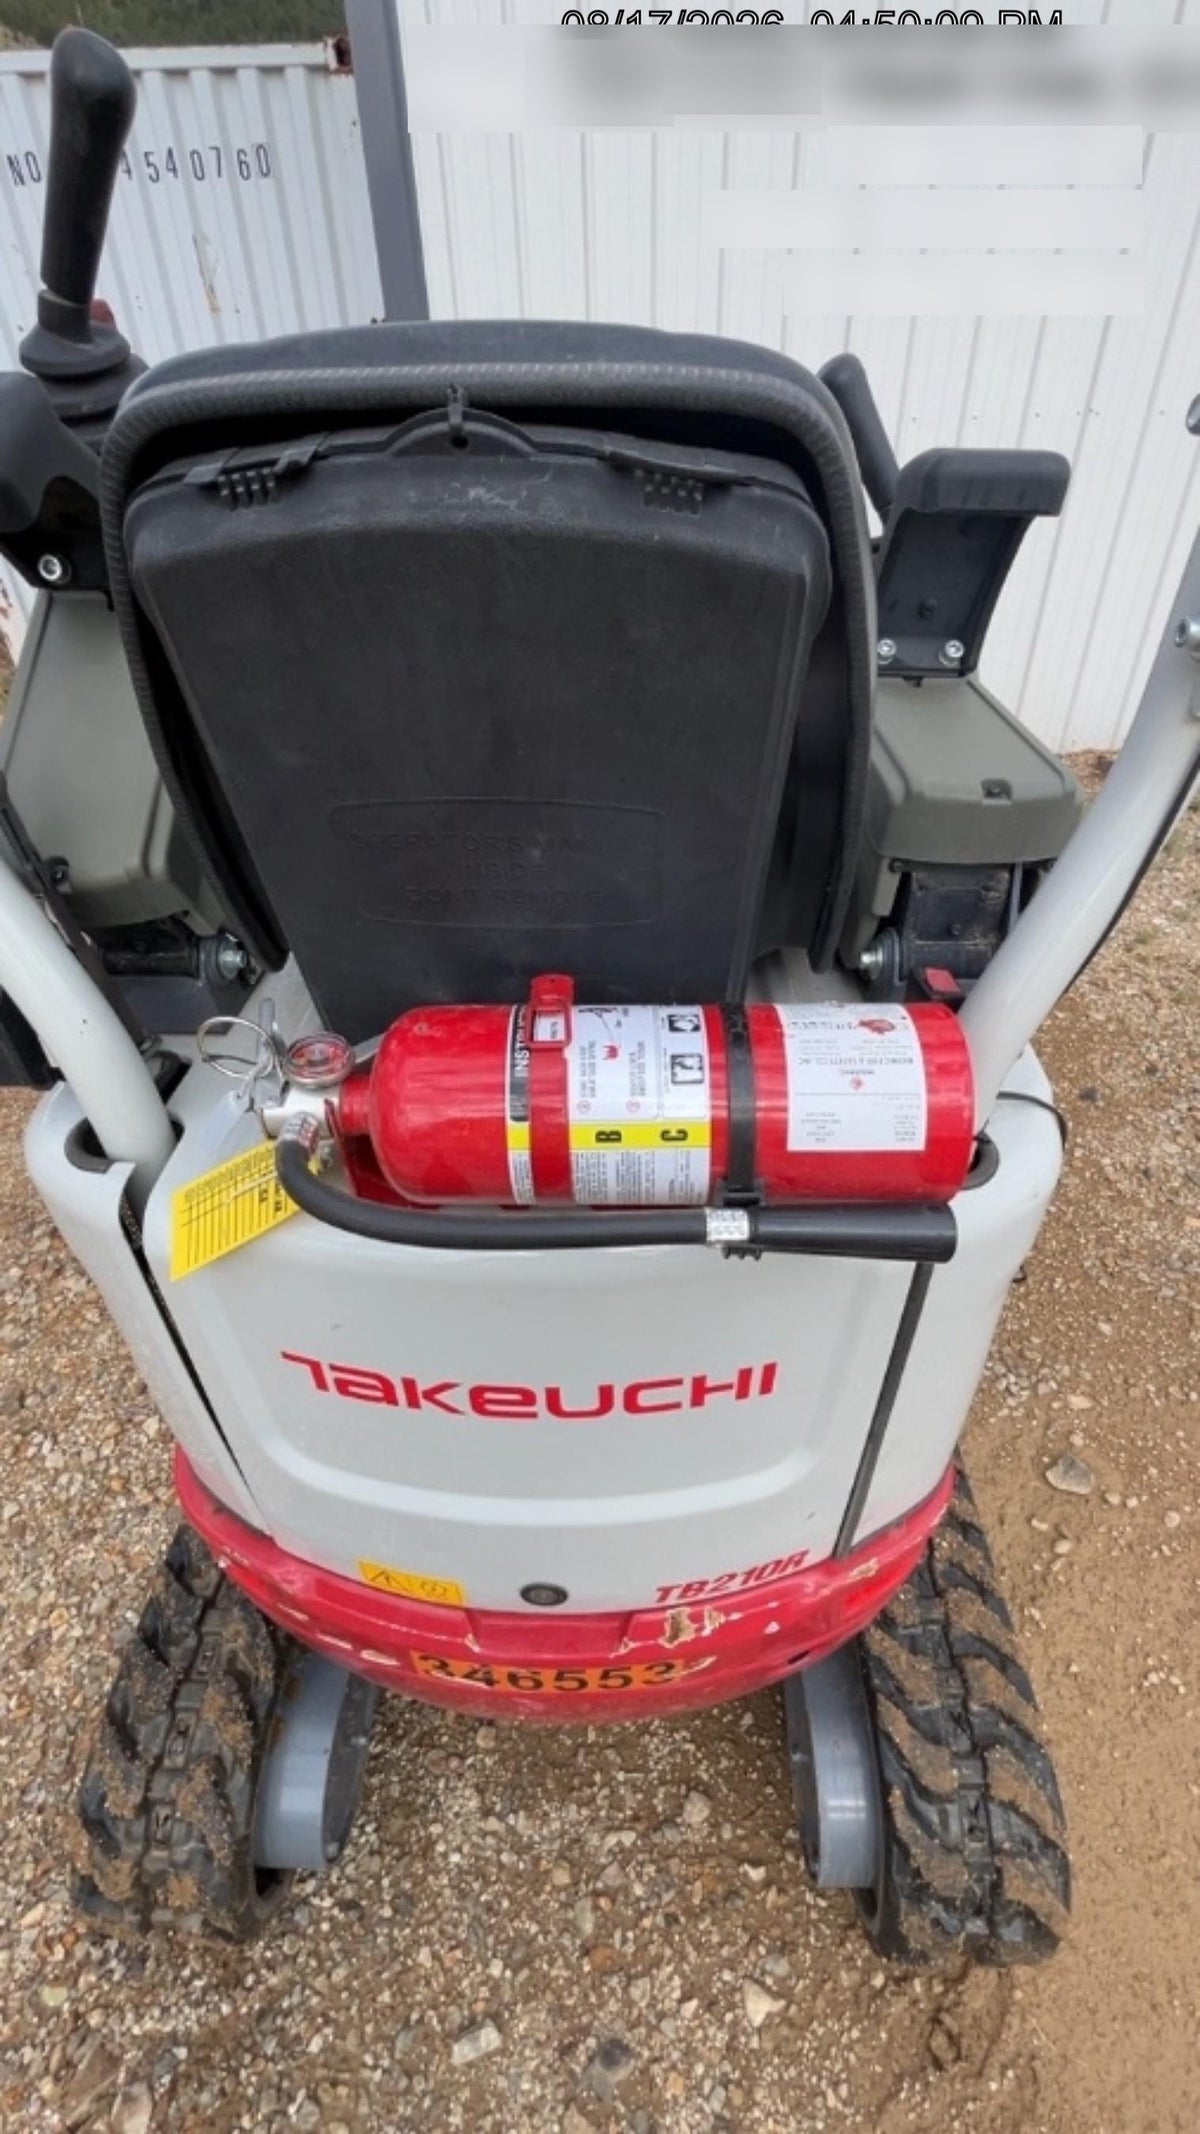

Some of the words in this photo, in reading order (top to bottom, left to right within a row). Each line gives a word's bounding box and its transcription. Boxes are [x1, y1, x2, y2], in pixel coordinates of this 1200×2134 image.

[595, 1130, 622, 1144] B
[661, 1128, 689, 1142] C
[281, 1351, 777, 1418] TAKEUCHI
[656, 1549, 810, 1603] TB210R
[418, 1655, 678, 1692] 346553
